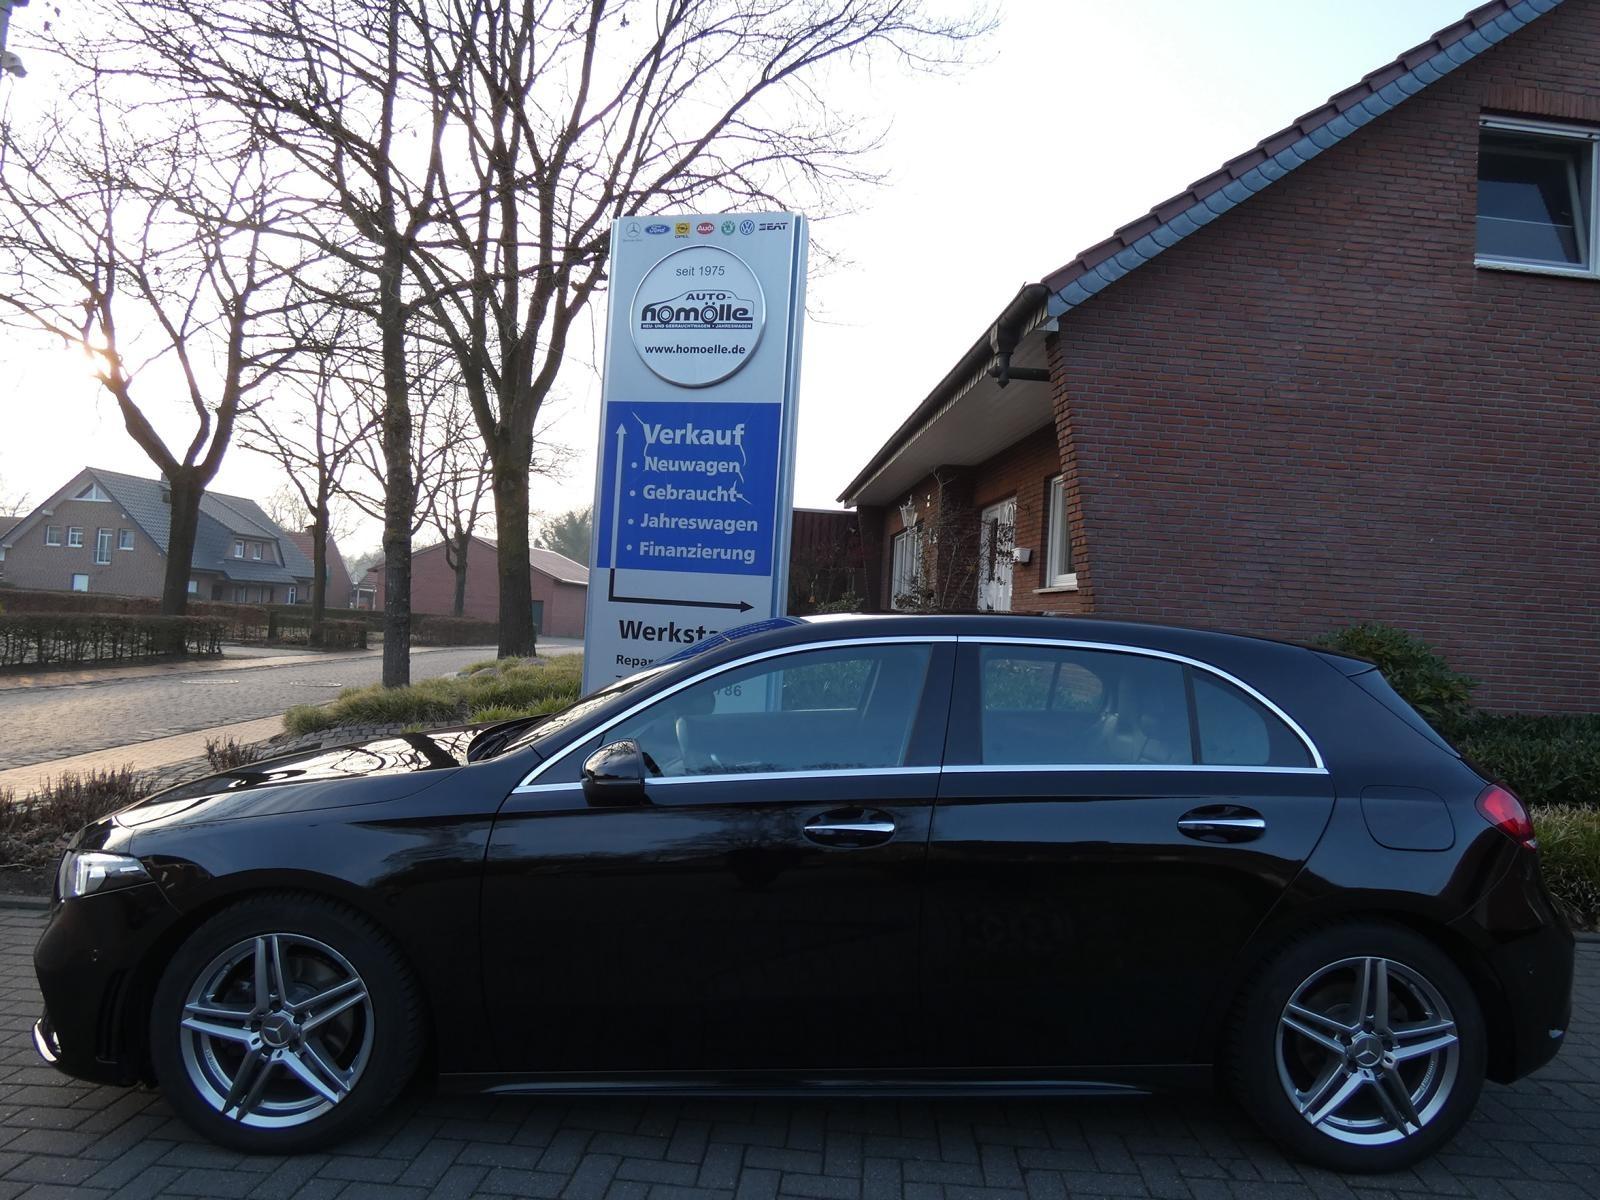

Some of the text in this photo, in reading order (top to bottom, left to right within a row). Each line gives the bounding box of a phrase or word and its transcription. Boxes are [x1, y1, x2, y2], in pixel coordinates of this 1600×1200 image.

[759, 222, 789, 231] SEAT
[675, 266, 725, 277] seit 1975
[685, 293, 732, 301] AUTO-
[644, 344, 746, 354] www.homoelle.de
[643, 423, 745, 446] Verkauf
[643, 456, 740, 476] Neuwagen
[640, 513, 758, 535] Jahreswagen
[639, 541, 756, 565] Finanzierung
[619, 619, 718, 644] Werkst
